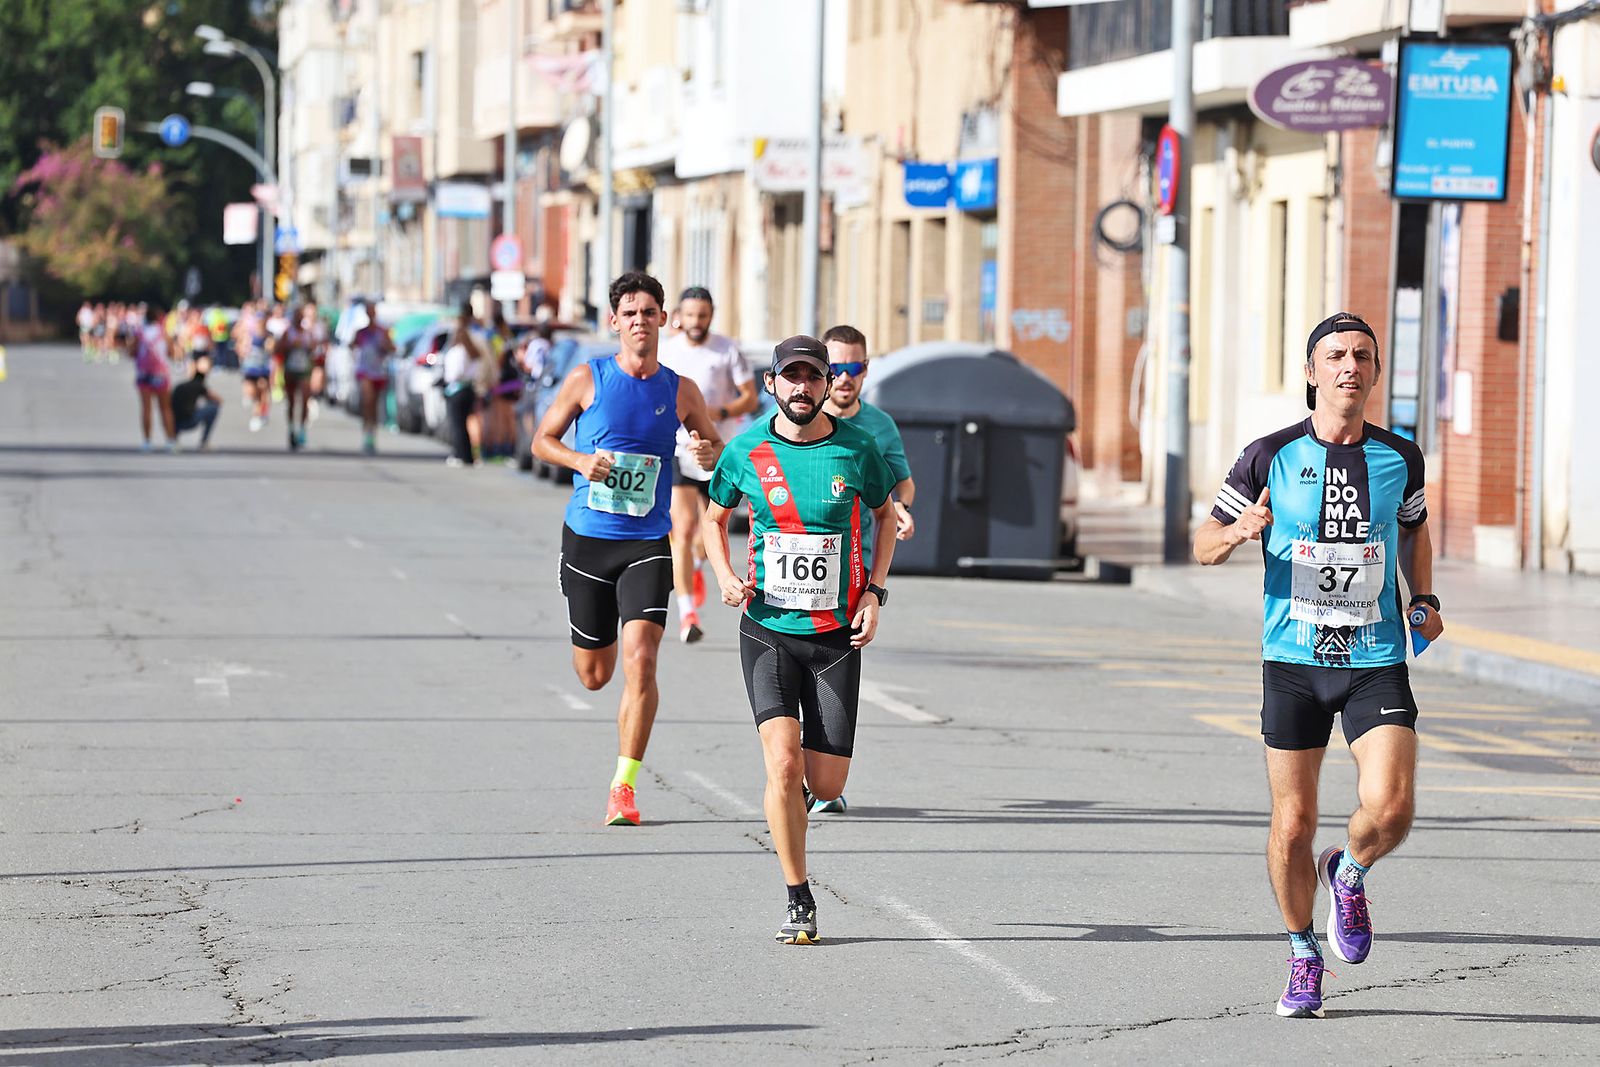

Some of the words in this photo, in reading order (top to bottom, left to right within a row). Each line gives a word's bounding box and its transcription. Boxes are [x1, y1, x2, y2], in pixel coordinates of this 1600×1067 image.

[1407, 74, 1498, 92] EMTUSA
[604, 469, 646, 492] 602
[1325, 467, 1348, 485] IN
[1325, 485, 1358, 503] DO
[1325, 503, 1363, 520] MA
[1324, 521, 1371, 538] BLE
[776, 555, 828, 581] 166
[1318, 566, 1359, 592] 37
[772, 585, 797, 594] GOMEZ
[1294, 595, 1334, 607] CABAÑAS
